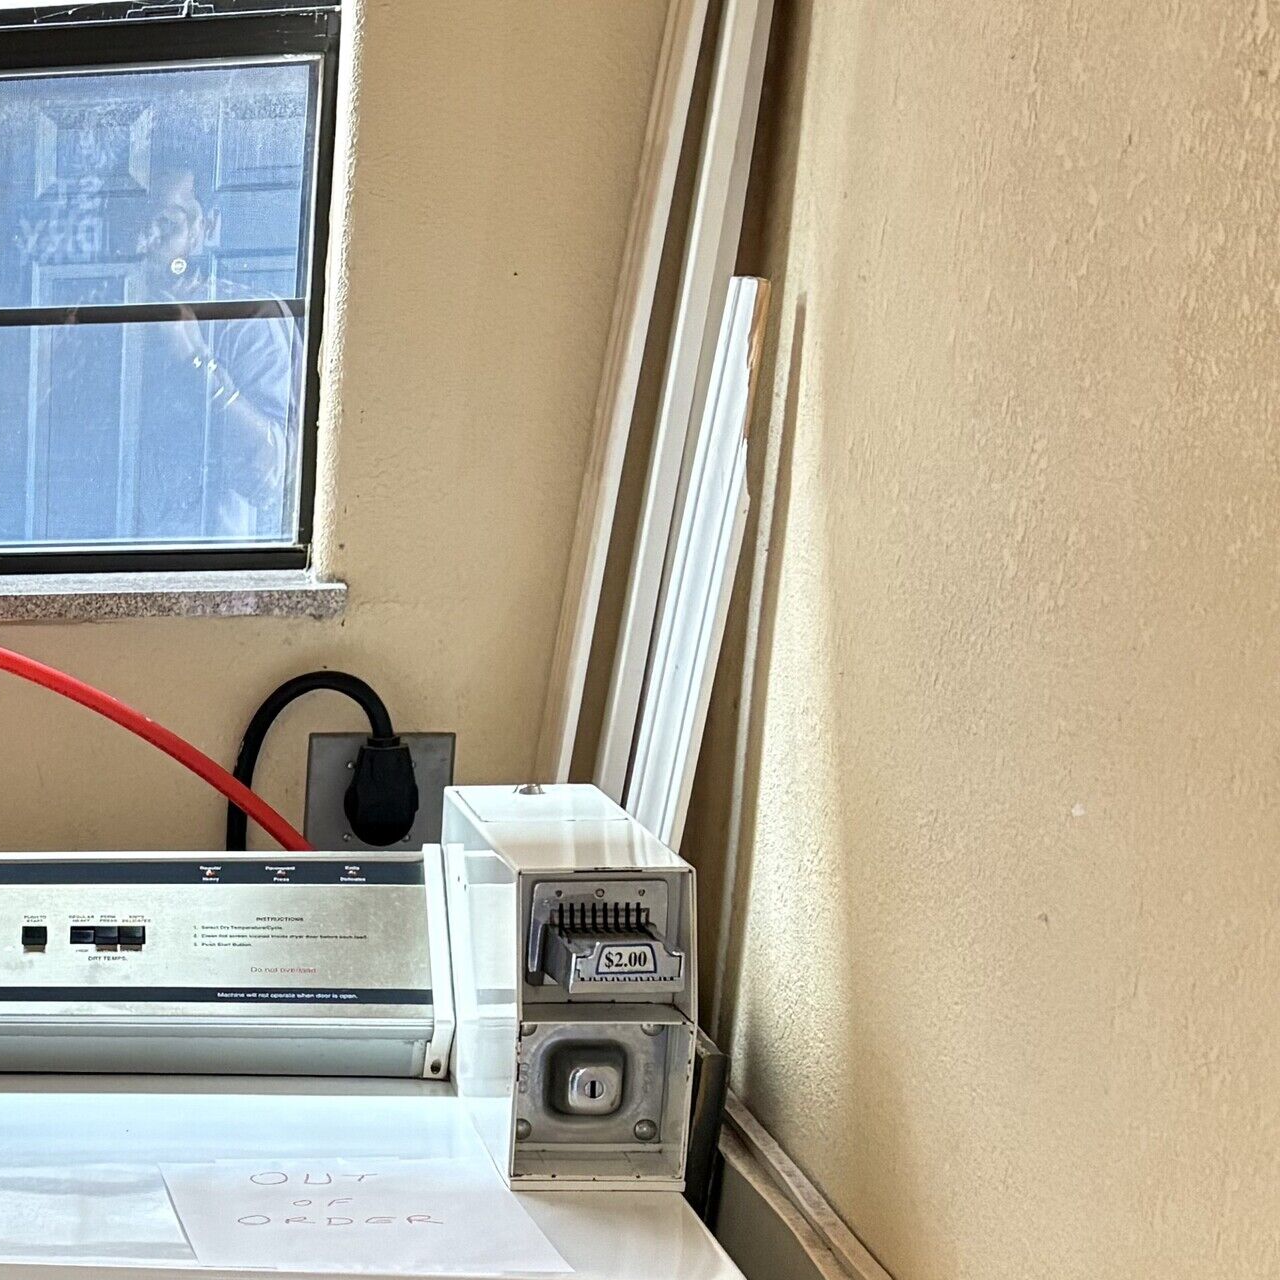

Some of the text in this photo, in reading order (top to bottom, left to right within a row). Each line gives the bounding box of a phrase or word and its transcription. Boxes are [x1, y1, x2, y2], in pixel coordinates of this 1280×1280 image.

[604, 951, 648, 969] $2.00
[249, 1171, 378, 1186] OUT
[292, 1197, 353, 1207] OF
[237, 1214, 444, 1226] ORDER
